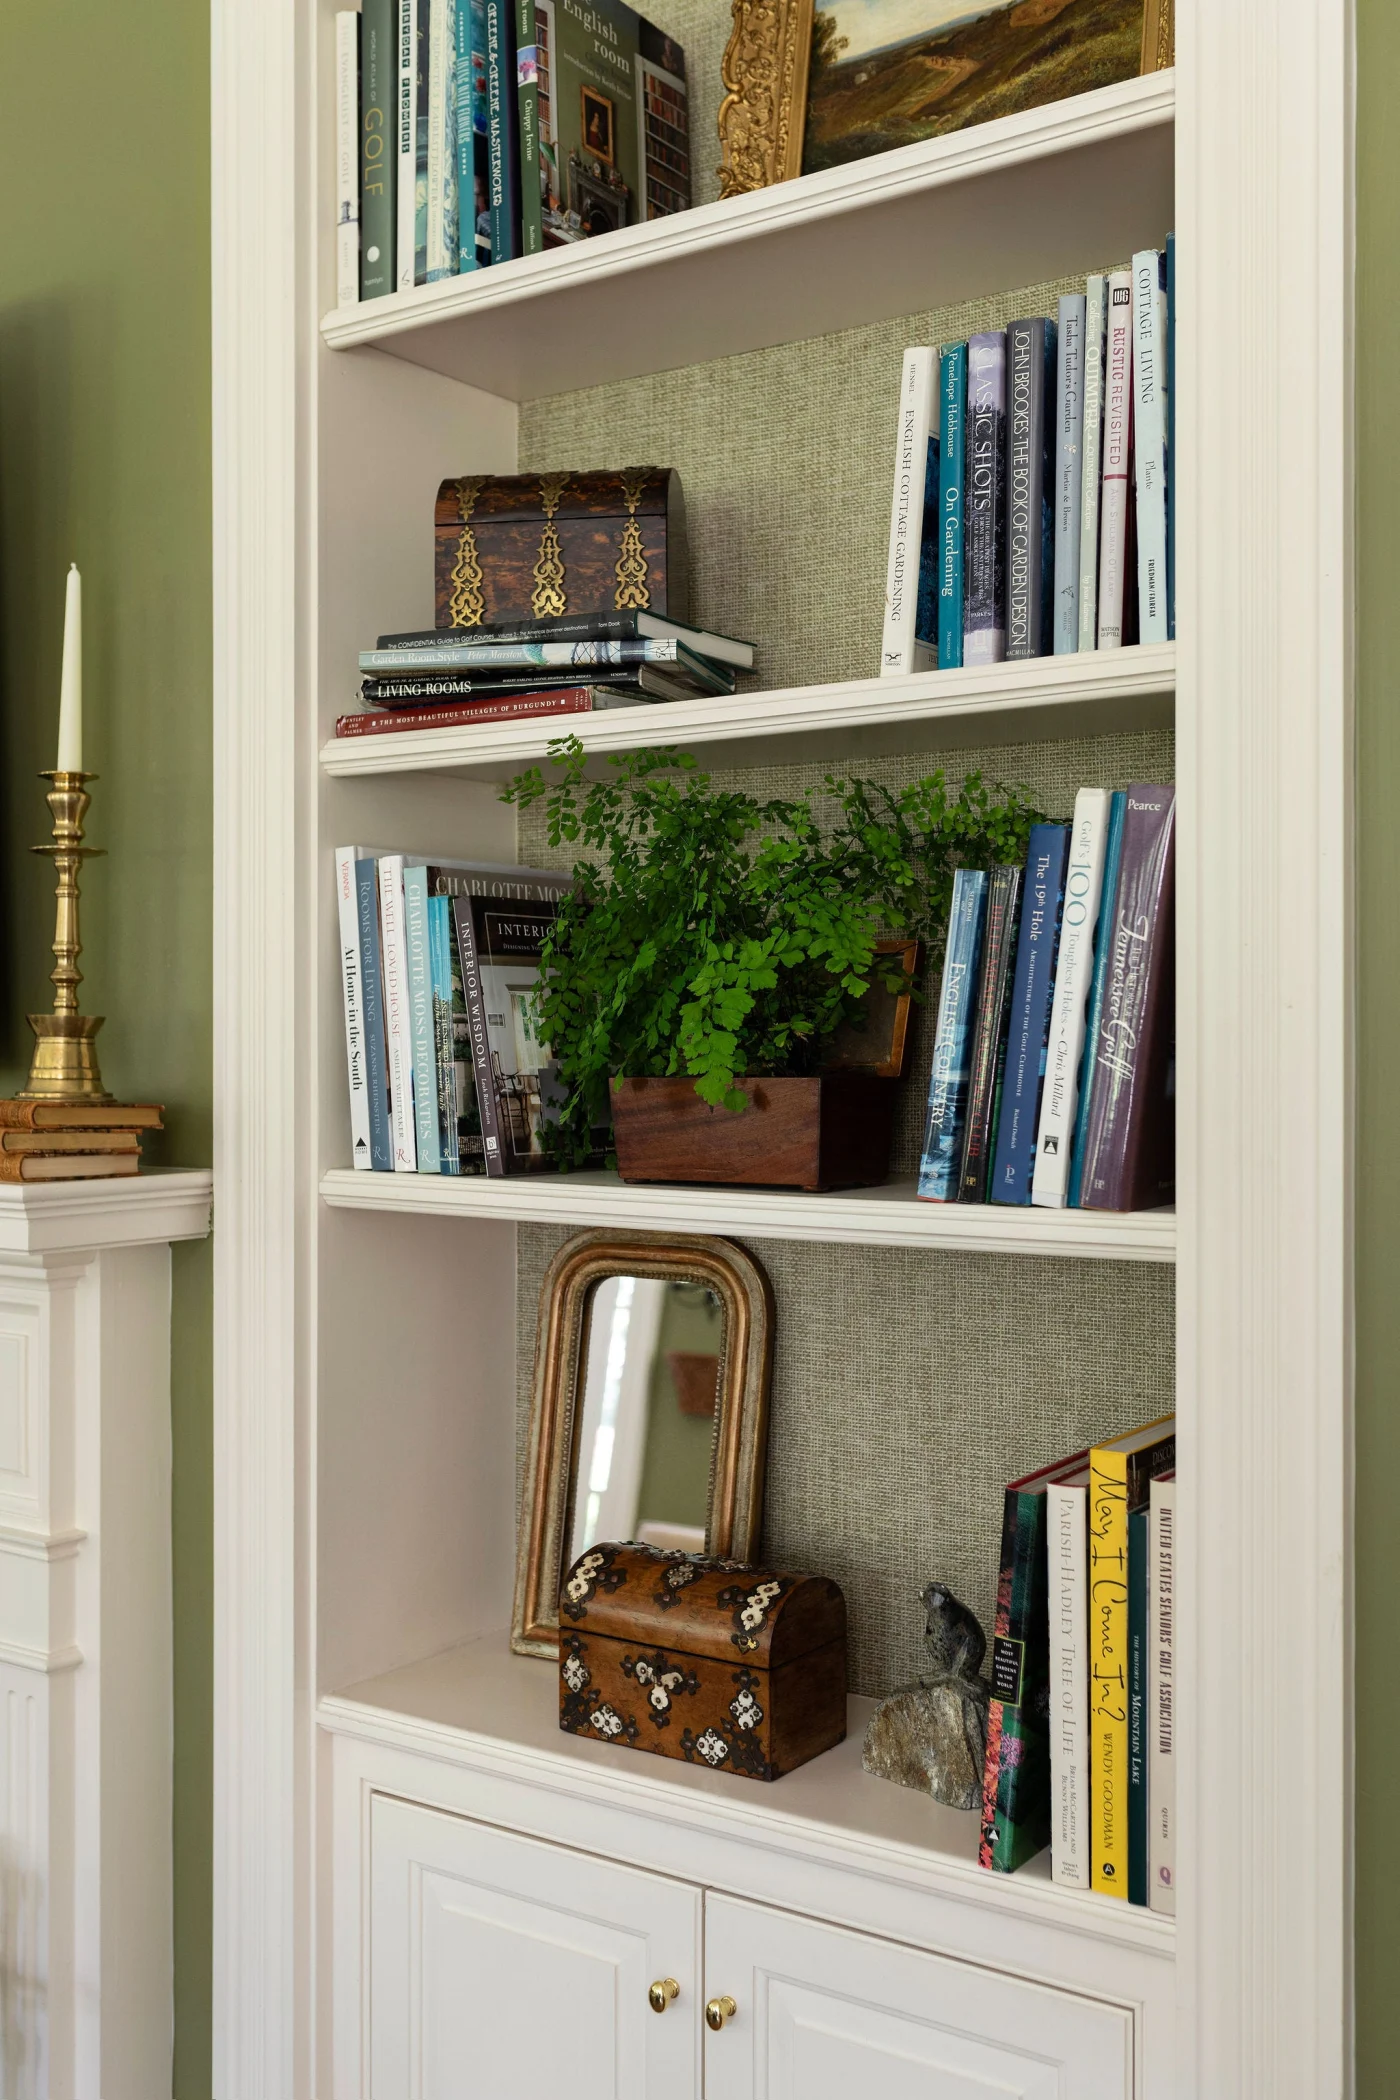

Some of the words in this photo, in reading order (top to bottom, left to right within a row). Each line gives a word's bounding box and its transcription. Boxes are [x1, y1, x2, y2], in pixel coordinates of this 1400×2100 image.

[563, 0, 619, 46] English
[594, 39, 630, 74] room
[341, 52, 349, 126] EVANGELIST
[370, 90, 376, 102] OF
[457, 84, 471, 107] WITH
[401, 78, 411, 153] FLOWERS
[457, 108, 471, 144] FLOWERS
[524, 99, 533, 131] Chippy
[341, 132, 349, 146] OF
[365, 107, 384, 196] GOLF
[525, 134, 534, 162] Irvine
[341, 152, 350, 185] GOLF
[489, 118, 502, 207] MASTERWORKS
[1087, 300, 1100, 342] Collecting
[1138, 268, 1152, 340] COTTAGE
[1014, 329, 1030, 369] JOHN
[1066, 315, 1079, 347] Tasha
[1065, 349, 1078, 389] Tudor's
[1112, 326, 1126, 380] RUSTIC
[908, 364, 916, 395] HENSEL
[946, 353, 958, 400] Penelope
[975, 347, 994, 437] CLASSIC
[1140, 349, 1154, 404] LIVING
[1013, 372, 1029, 435] BROOKES
[1064, 390, 1076, 434] Garden
[902, 410, 915, 469] ENGLISH
[947, 404, 958, 458] Hobhouse
[1109, 386, 1123, 465] REVISITED
[1013, 438, 1029, 466] THE
[973, 441, 992, 511] SHOTS
[1012, 468, 1028, 511] BOOK
[1063, 464, 1073, 492] Martin
[1144, 460, 1156, 490] Plante
[897, 474, 910, 538] COTTAGE
[945, 487, 959, 511] On
[1063, 495, 1071, 503] &
[1084, 490, 1095, 530] Collections
[1109, 488, 1119, 507] ANN
[1012, 512, 1028, 531] OF
[1062, 506, 1072, 532] Brown
[1109, 511, 1118, 554] STILLMAN
[941, 517, 959, 597] Gardening
[1011, 535, 1028, 594] GARDEN
[891, 542, 906, 622] GARDENING
[1147, 559, 1156, 618] FRIEDMAN/FAIRFAX
[1011, 597, 1027, 646] DESIGN
[372, 652, 405, 665] Garden
[408, 651, 436, 663] Room
[437, 651, 460, 666] Style
[398, 641, 436, 649] CONFIDENTIAL
[467, 651, 489, 661] Peter
[490, 650, 523, 660] Marston
[379, 719, 393, 727] THE
[397, 715, 416, 724] MOST
[418, 712, 459, 722] BEAUTIFUL
[462, 708, 498, 717] VILLAGES
[513, 700, 557, 711] BURGUNDY
[1127, 798, 1161, 811] Pearce
[1077, 820, 1092, 858] Golf's
[341, 861, 350, 900] VERANDA
[383, 867, 393, 898] THE
[1035, 854, 1050, 879] The
[360, 881, 371, 933] ROOMS
[966, 891, 974, 922] SEEBOHM
[1034, 883, 1047, 907] 19th
[1065, 861, 1092, 927] 100
[385, 900, 394, 936] WELL
[408, 884, 425, 985] CHARLOTTE
[1029, 910, 1044, 941] Hole
[344, 947, 355, 960] At
[363, 938, 372, 964] FOR
[387, 944, 398, 988] LOVED
[1063, 931, 1081, 986] Toughest
[1109, 909, 1149, 1018] Tennessee
[345, 965, 357, 1005] Home
[364, 969, 375, 1022] LIVING
[460, 922, 478, 999] INTERIOR
[471, 1004, 487, 1069] WISDOM
[1024, 949, 1038, 1003] ARCHITECTURE
[348, 1009, 359, 1025] in
[390, 992, 400, 1038] HOUSE
[414, 990, 427, 1035] MOSS
[941, 962, 967, 1038] ENGLISH
[1024, 1004, 1031, 1015] OF
[1060, 990, 1074, 1024] Holes
[349, 1026, 361, 1048] the
[1020, 1032, 1029, 1053] GOLF
[1022, 1017, 1030, 1030] THE
[369, 1033, 377, 1077] SUZANNE
[393, 1047, 401, 1081] ASHLEY
[1054, 1040, 1069, 1071] Chris
[1097, 1018, 1136, 1079] Golf
[350, 1051, 363, 1091] South
[416, 1040, 431, 1140] DECORATES
[480, 1078, 488, 1093] Leah
[930, 1041, 956, 1128] COUNTRY
[1014, 1054, 1027, 1097] CLUBHOUSE
[372, 1079, 381, 1135] RHEINSTEIN
[396, 1084, 404, 1139] WHITTAKER
[482, 1094, 493, 1125] Richardson
[1050, 1073, 1066, 1118] Millard
[1012, 1108, 1020, 1128] Richard
[1010, 1128, 1018, 1149] Diedrich
[1090, 1466, 1127, 1541] May
[1159, 1508, 1173, 1548] UNITED
[1060, 1499, 1076, 1639] PARISH-HADLEY
[1092, 1544, 1125, 1572] I
[1159, 1552, 1172, 1593] STATES
[1092, 1579, 1127, 1658] Come
[1159, 1596, 1172, 1647] SENIORS'
[1061, 1644, 1077, 1689] TREE
[1132, 1650, 1140, 1678] HISTORY
[1158, 1650, 1172, 1678] GOLF
[996, 1680, 1013, 1689] WORLD
[1061, 1692, 1074, 1713] OF
[1092, 1663, 1126, 1722] In?
[1133, 1680, 1140, 1691] OF
[1061, 1719, 1077, 1757] LIFE
[1131, 1694, 1142, 1754] MOUNTAIN
[1158, 1682, 1172, 1756] ASSOCIATION
[1102, 1732, 1114, 1777] WENDY
[1131, 1757, 1142, 1785] LAKE
[1061, 1774, 1069, 1802] BUNNY
[1068, 1765, 1077, 1789] BRIAN
[1061, 1804, 1069, 1843] WILLIAMS
[1101, 1779, 1114, 1850] GOODMAN
[1160, 1806, 1170, 1840] QUIRIN
